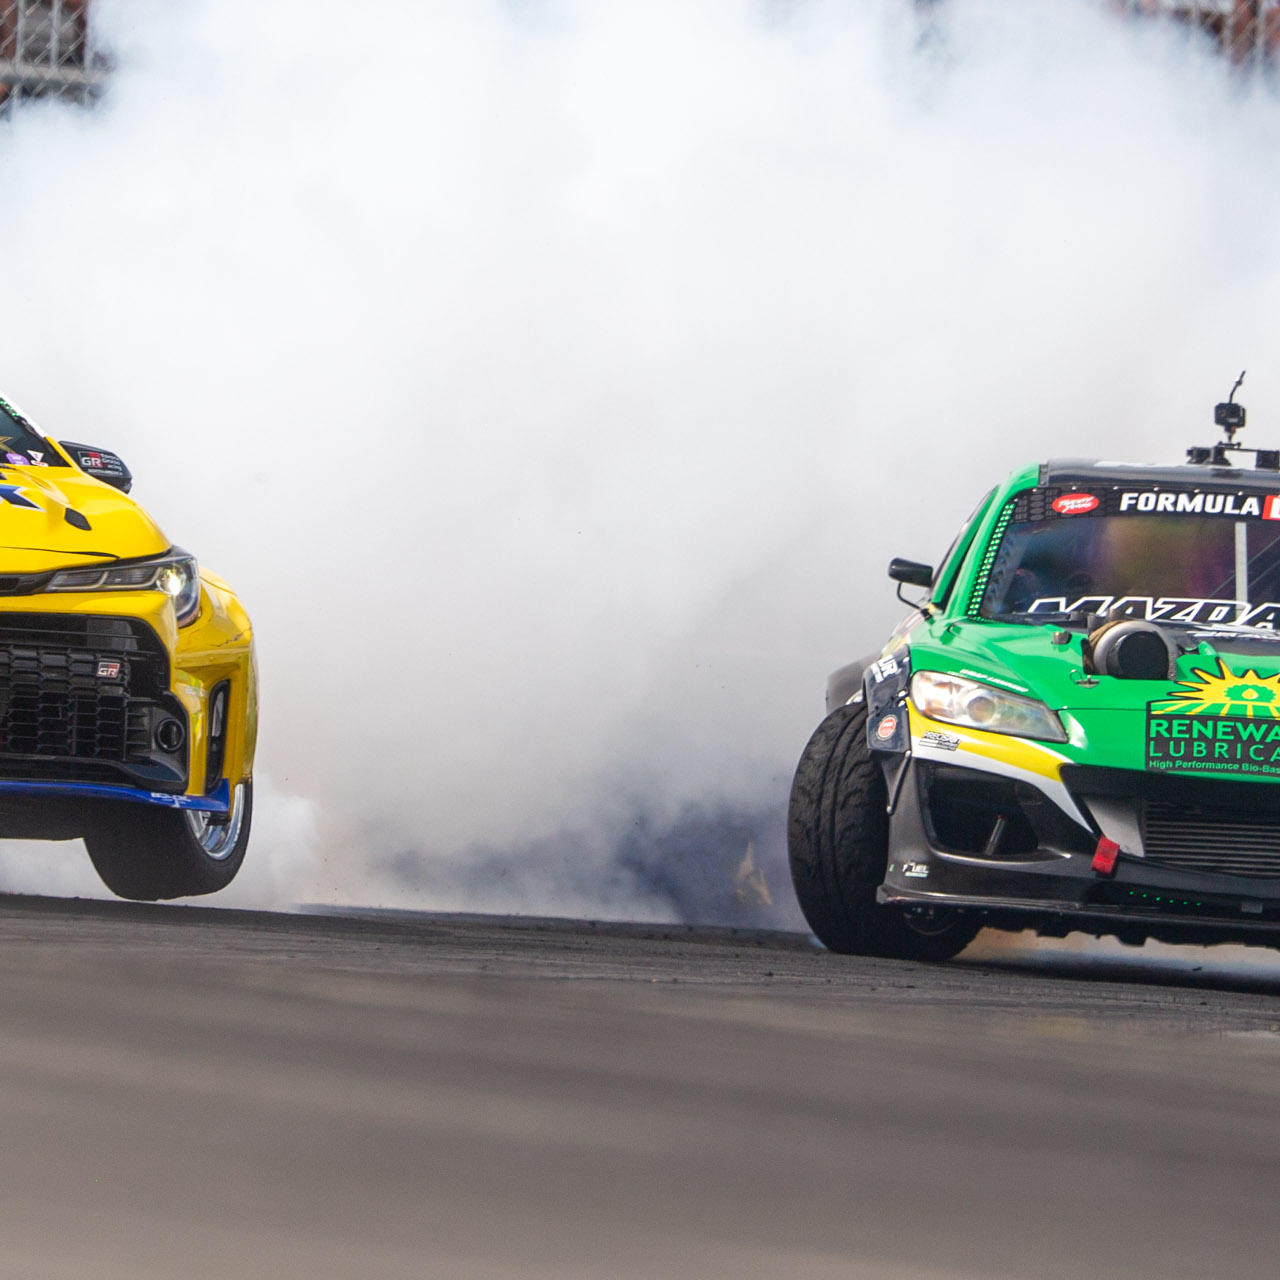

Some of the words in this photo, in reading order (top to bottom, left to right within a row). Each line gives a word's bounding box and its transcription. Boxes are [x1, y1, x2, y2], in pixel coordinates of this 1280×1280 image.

[1120, 492, 1261, 517] FORMULA
[1149, 760, 1173, 770] High
[1175, 760, 1240, 771] Performance
